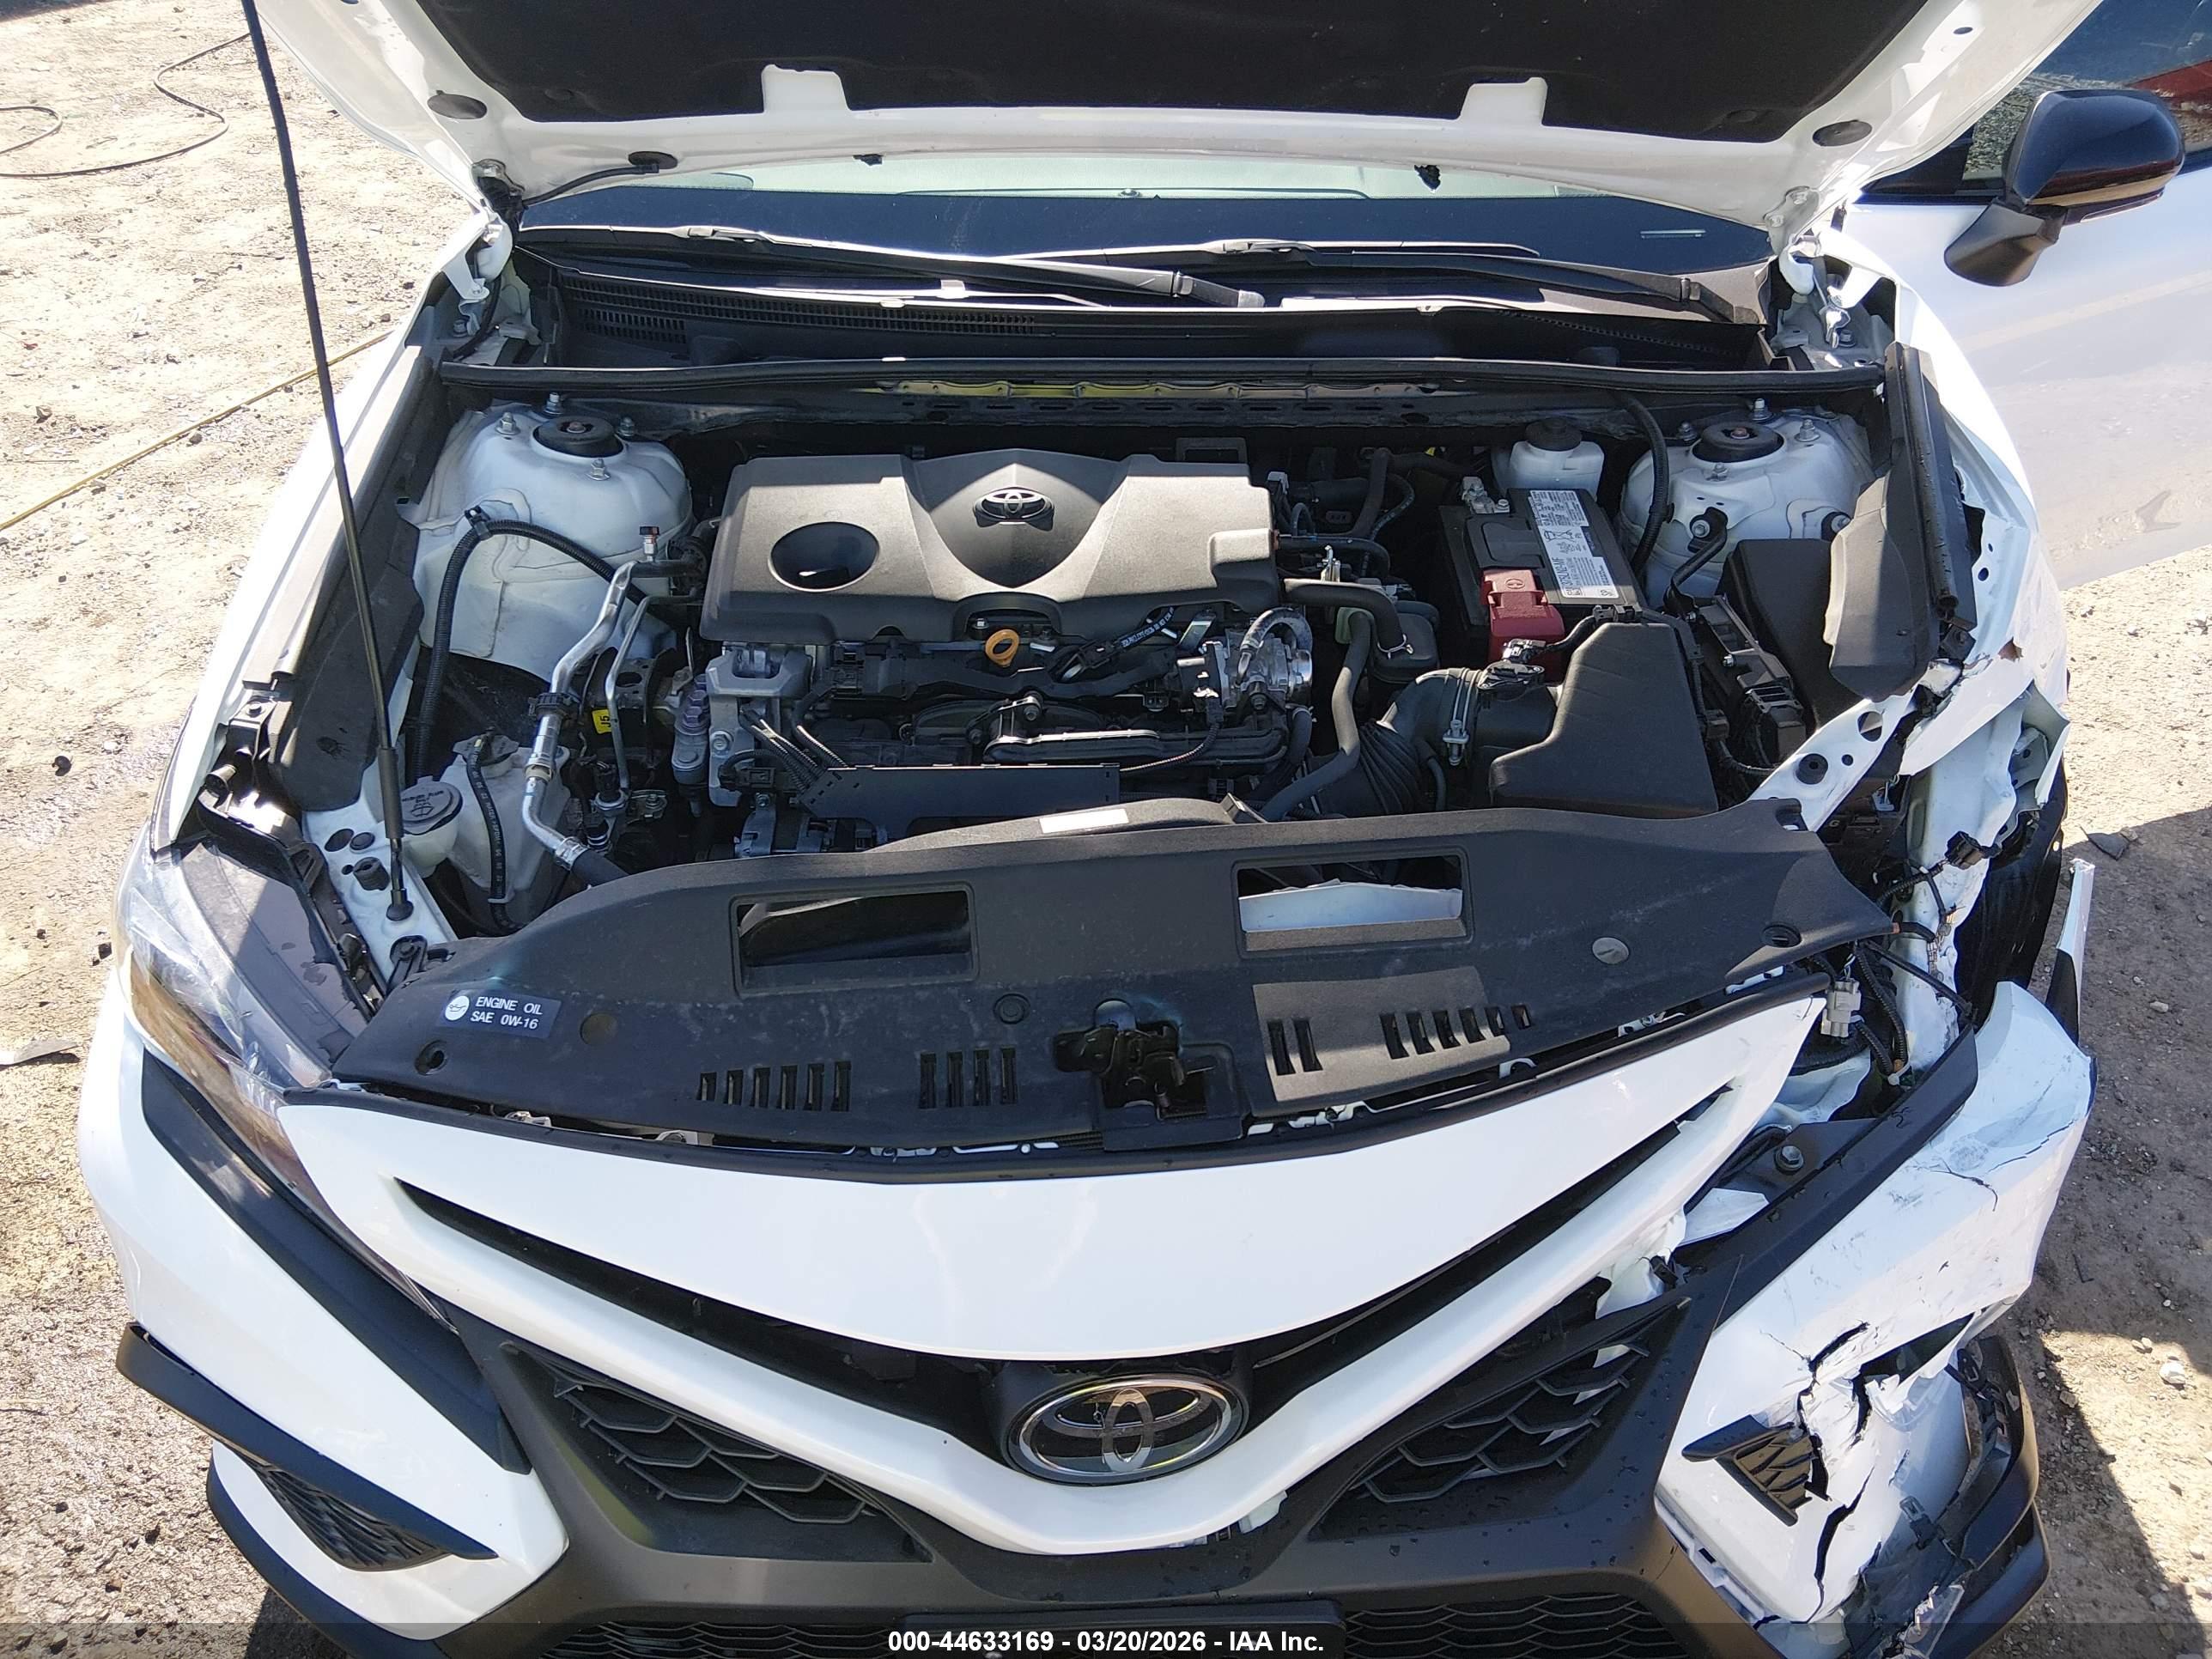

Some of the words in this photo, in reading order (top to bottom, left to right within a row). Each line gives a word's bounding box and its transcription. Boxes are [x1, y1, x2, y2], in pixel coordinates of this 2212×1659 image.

[476, 996, 518, 1012] ENGINE
[524, 1002, 543, 1015] OIL
[470, 1011, 495, 1024] SAE
[501, 1014, 538, 1030] 0W-16
